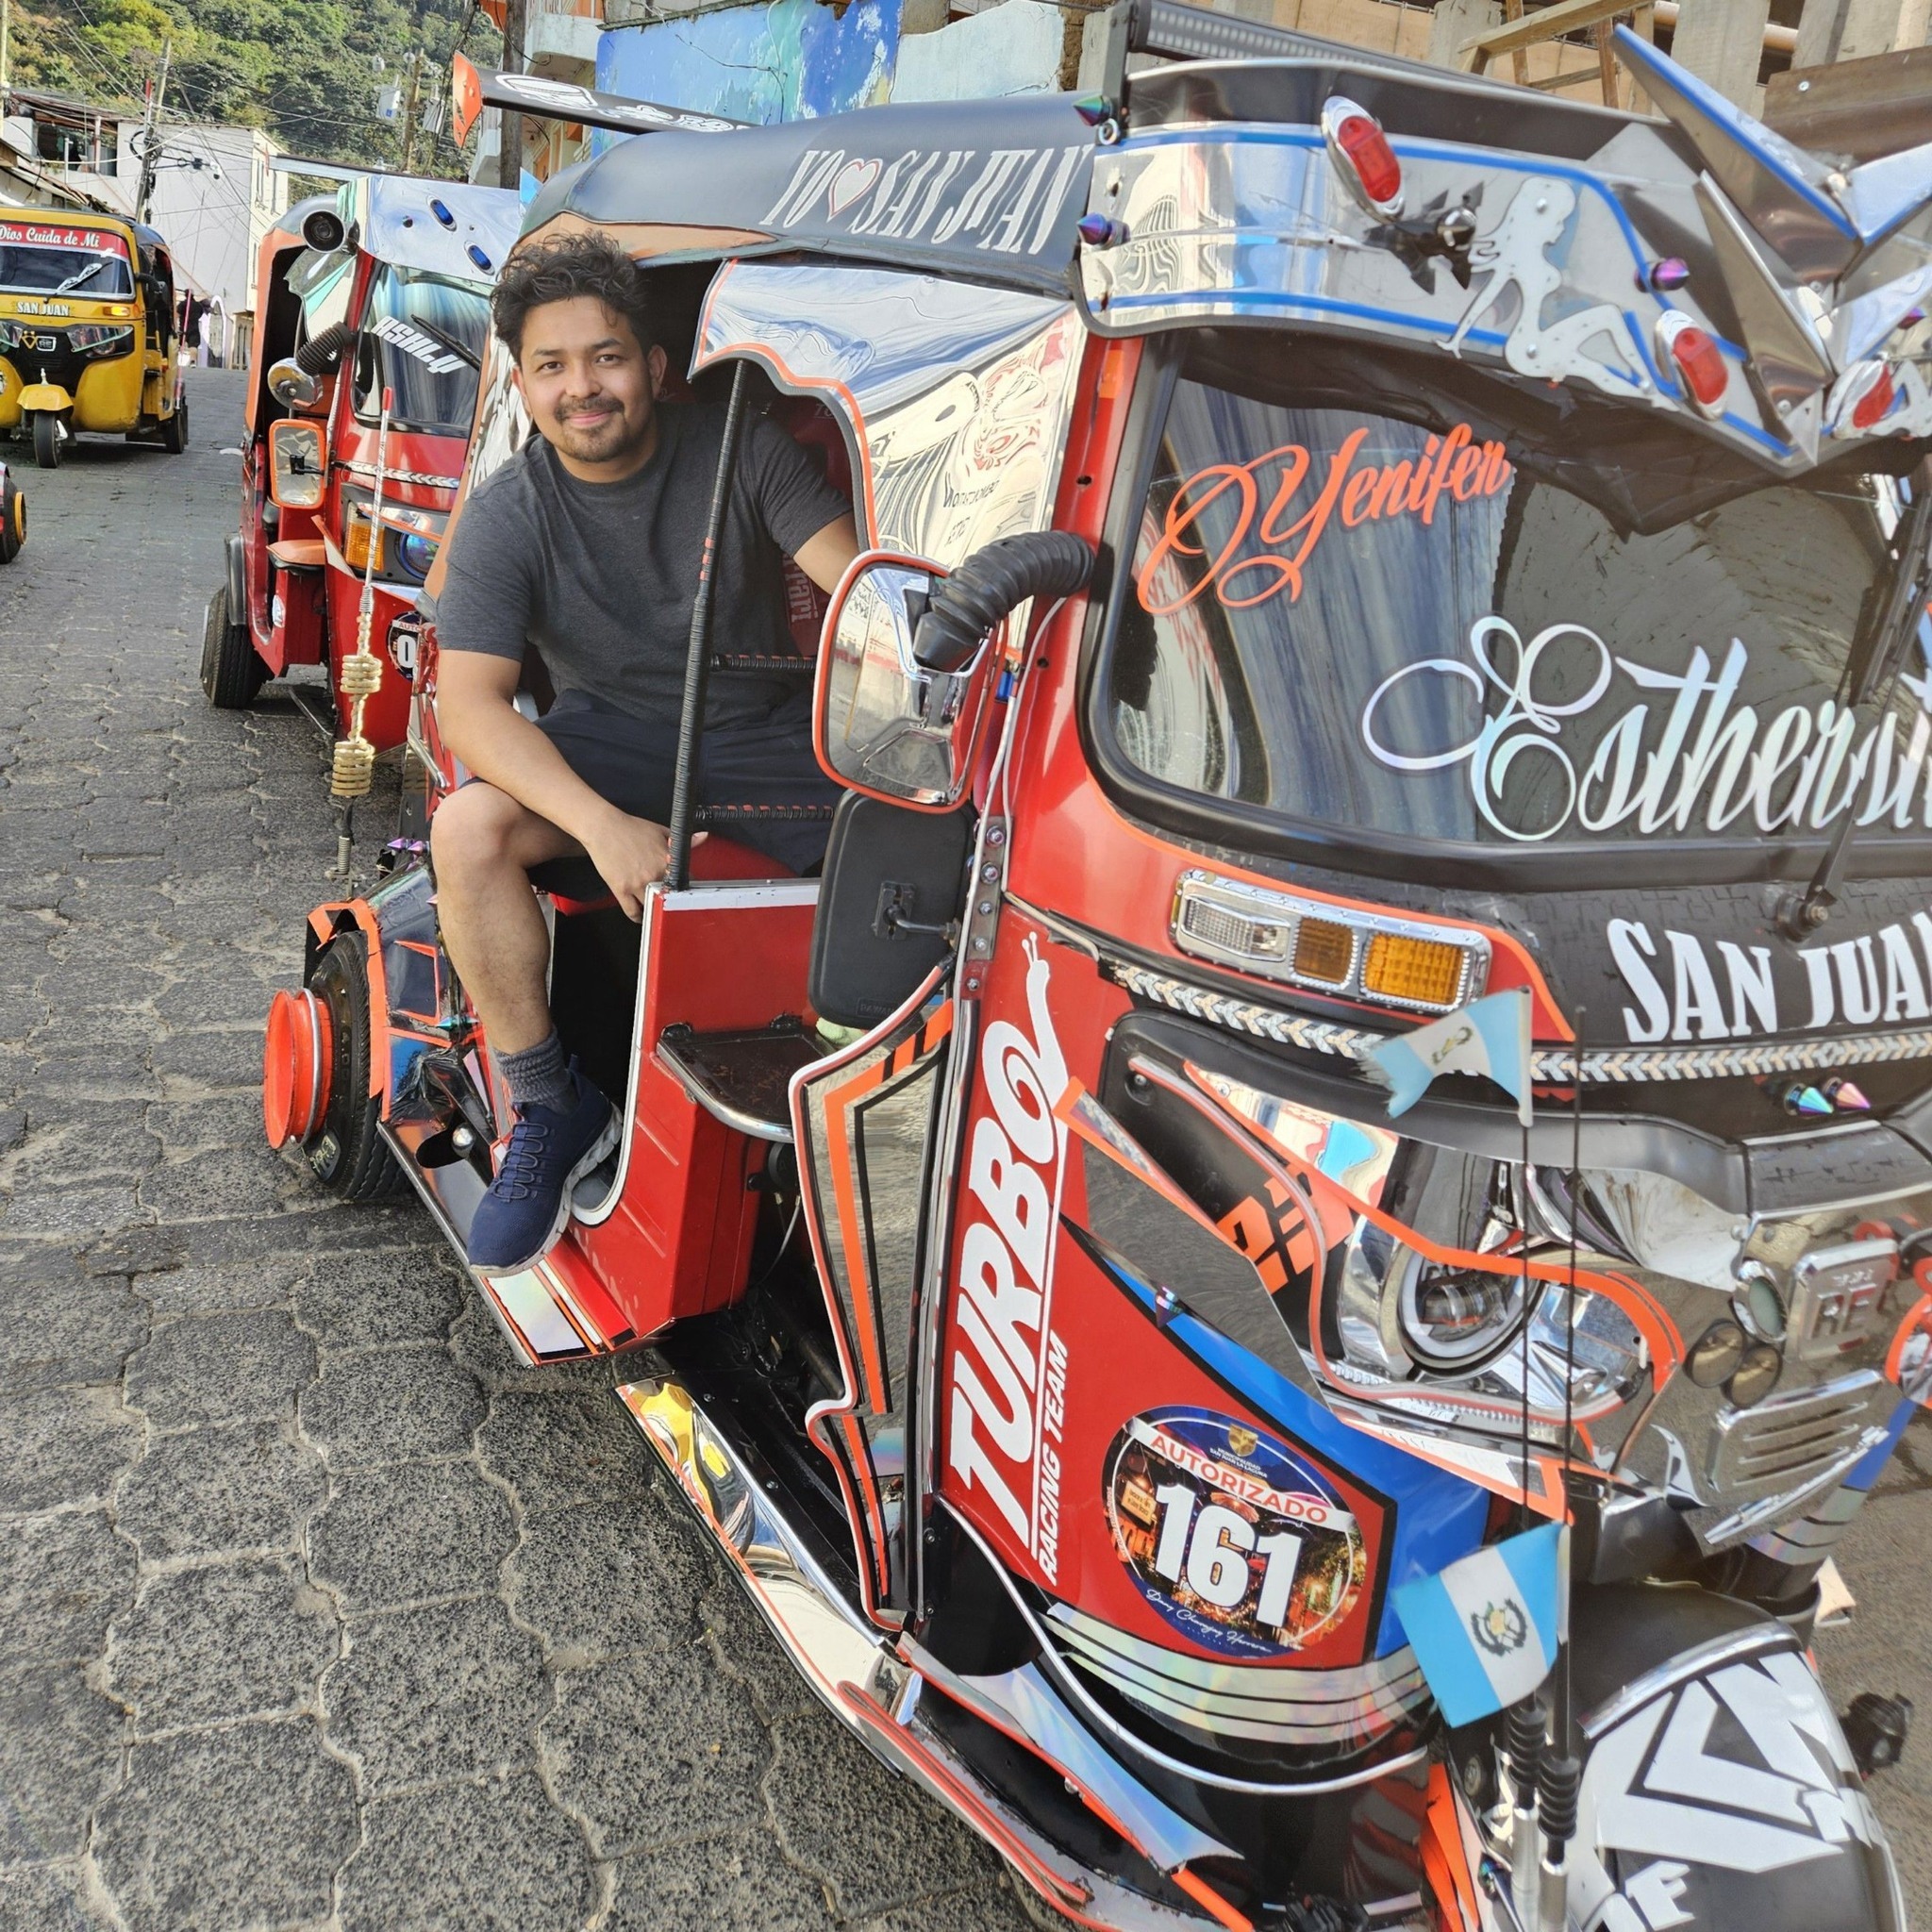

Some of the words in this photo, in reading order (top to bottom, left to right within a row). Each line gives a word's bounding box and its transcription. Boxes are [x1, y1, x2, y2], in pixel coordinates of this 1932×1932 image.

[0, 225, 23, 241] Dios
[26, 227, 61, 244] Cuida
[63, 230, 78, 245] de
[80, 232, 100, 247] Mi
[758, 149, 845, 228] YO
[846, 149, 975, 239] SAN
[930, 143, 1095, 255] JUAN
[17, 302, 39, 314] SAN
[42, 304, 69, 317] JUAN
[371, 316, 468, 374] ASHLY
[1138, 423, 1513, 615] Yenifer
[1607, 918, 1778, 1043] SAN
[949, 1019, 1066, 1550] TURBO
[1043, 1329, 1068, 1444] TEAM
[1039, 1441, 1061, 1587] RACING
[1150, 1435, 1327, 1524] AUTORIZADO
[1222, 1454, 1237, 1465] JUAN
[1244, 1465, 1268, 1478] LAGUNA
[1156, 1483, 1303, 1628] 161
